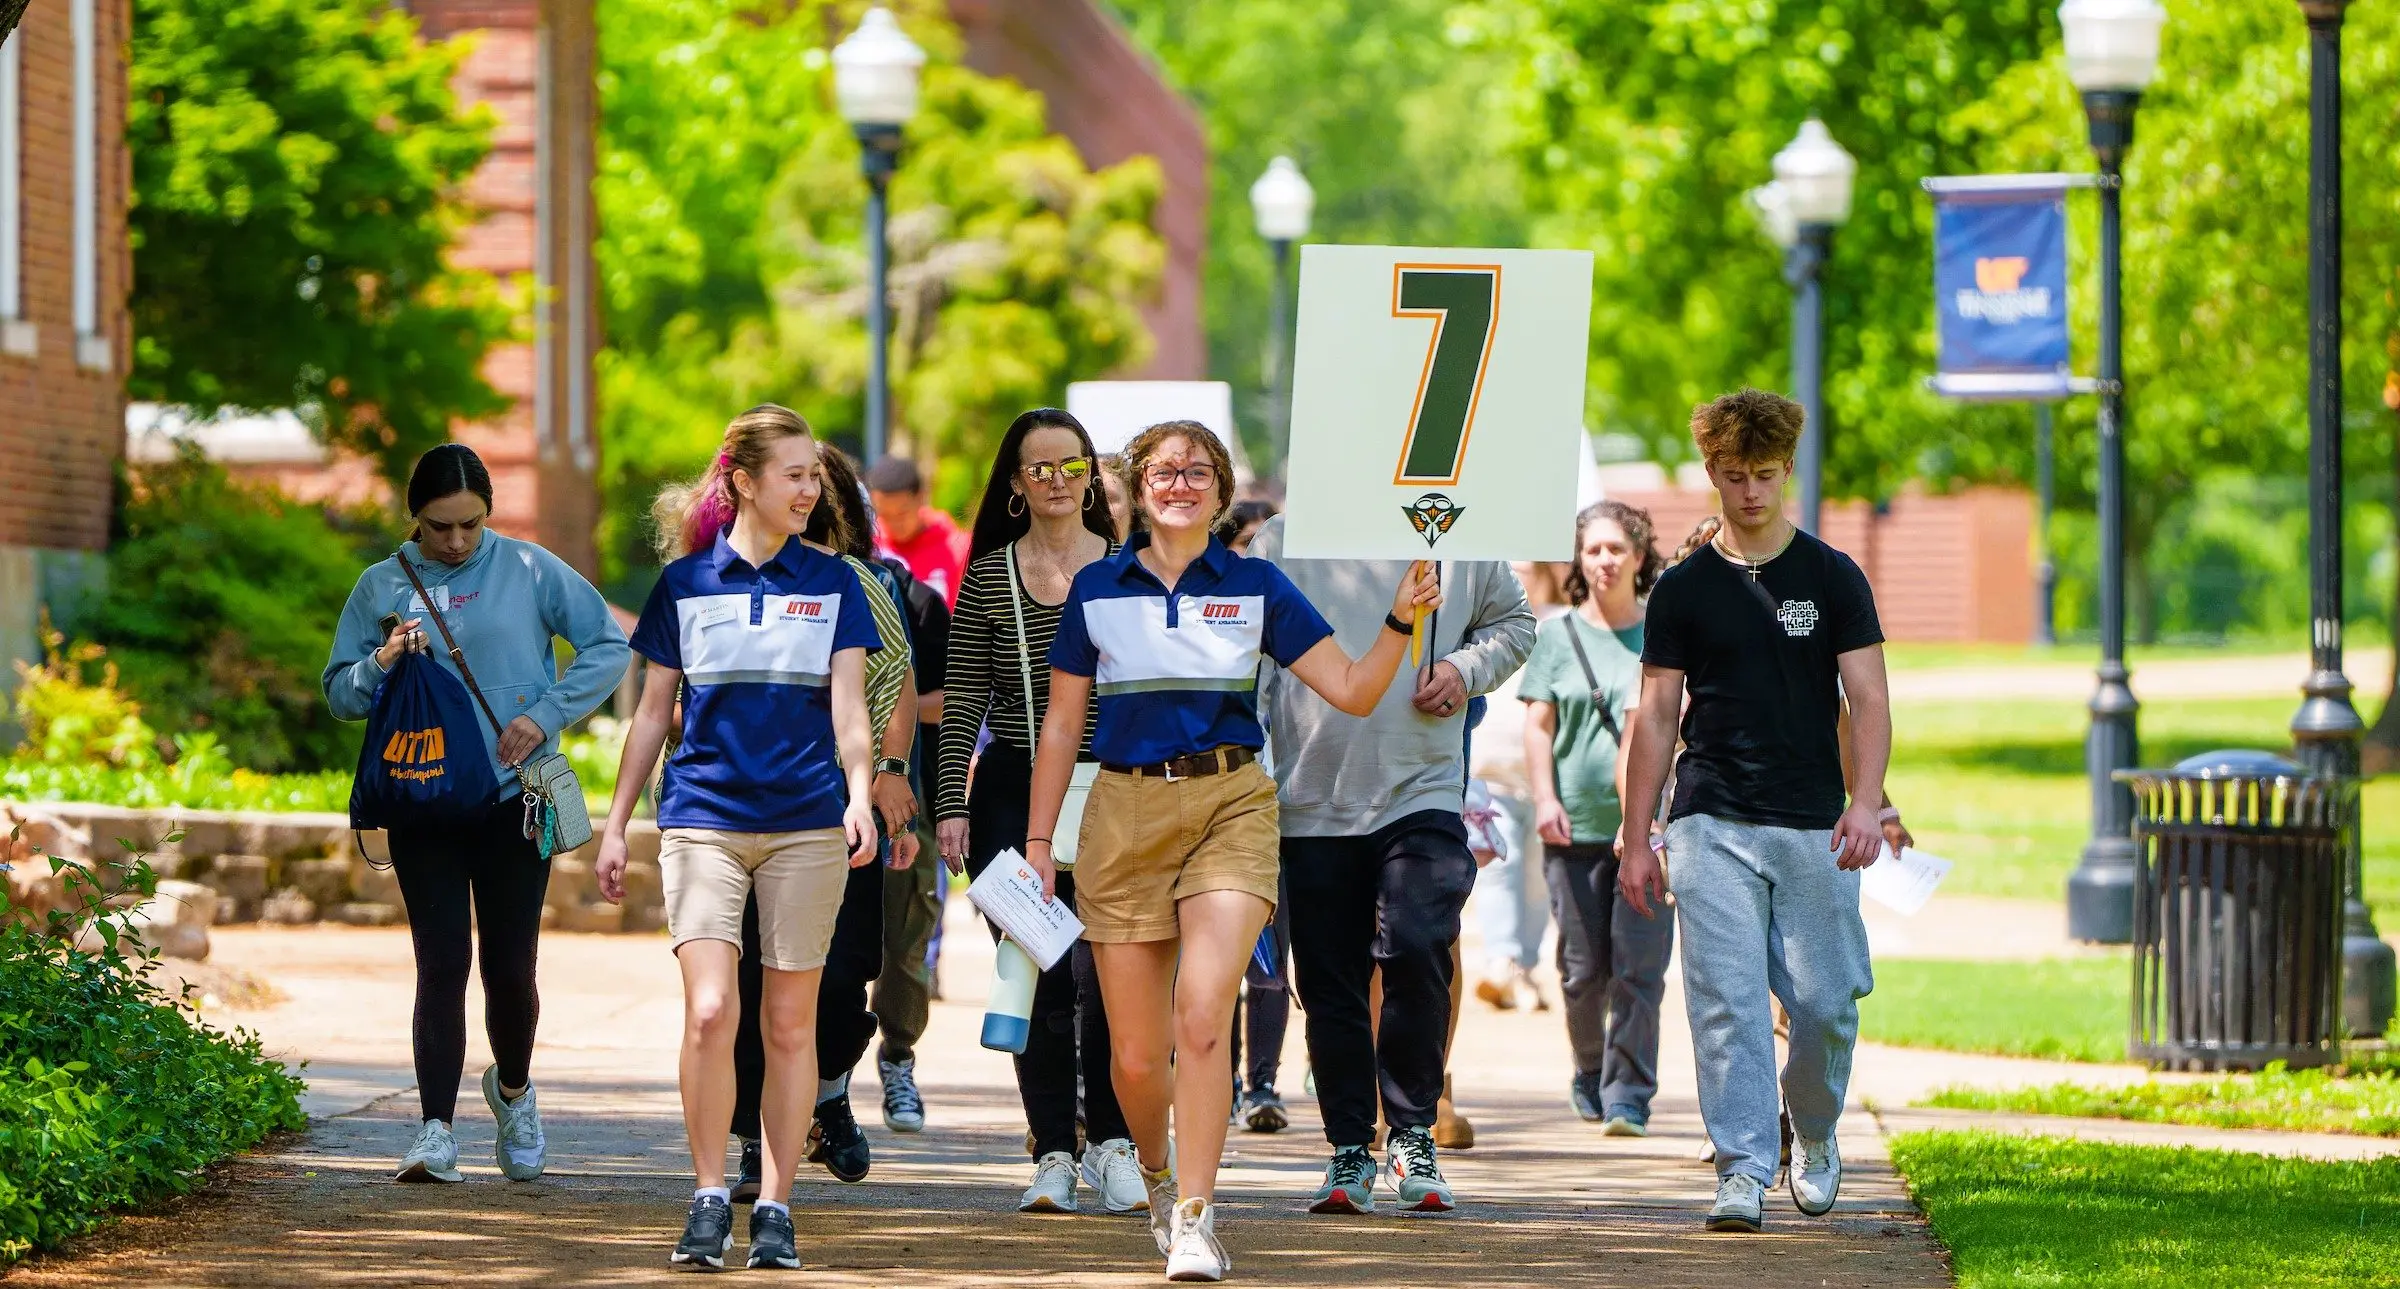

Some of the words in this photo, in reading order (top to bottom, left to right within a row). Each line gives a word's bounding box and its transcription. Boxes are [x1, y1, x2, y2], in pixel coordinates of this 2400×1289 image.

[1391, 263, 1502, 486] 7
[787, 601, 823, 616] UTM
[1203, 603, 1240, 618] UTM
[1784, 600, 1813, 611] Shout
[1778, 610, 1818, 620] Praises
[383, 727, 445, 764] UTM
[1029, 880, 1067, 921] MATIN
